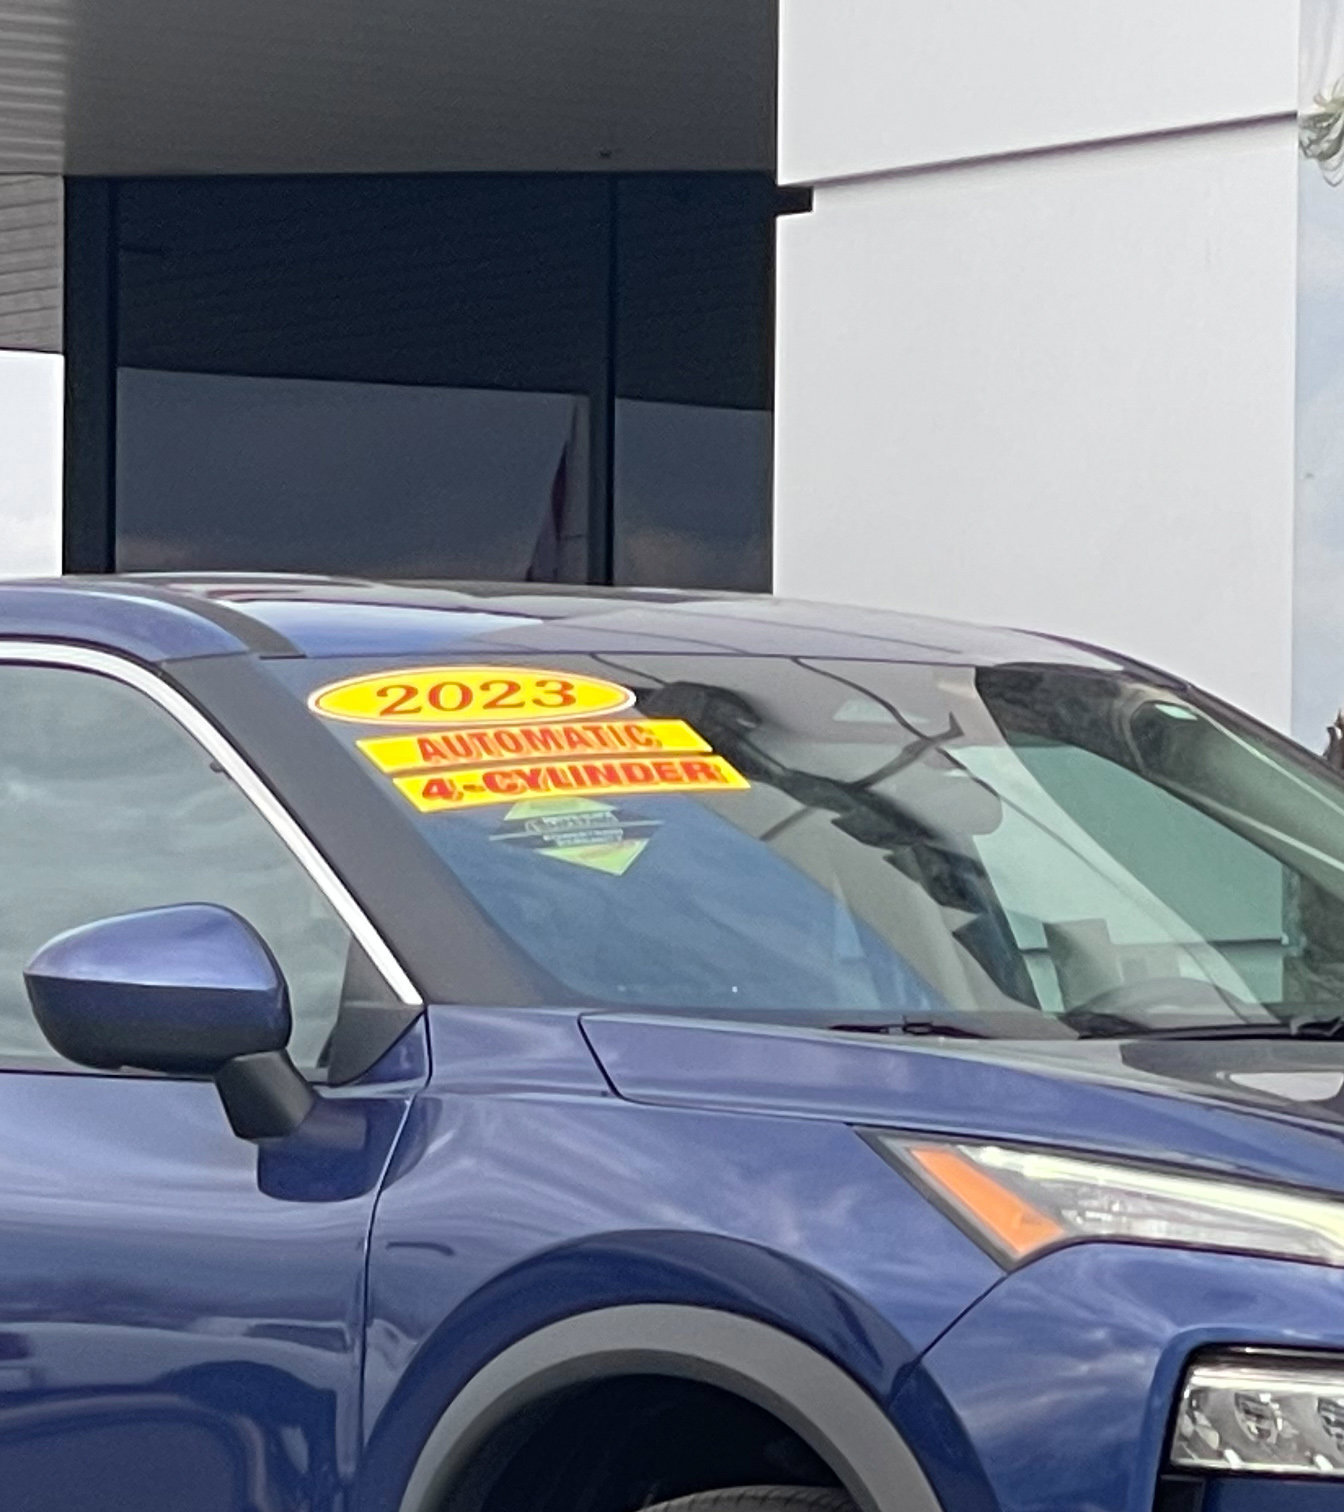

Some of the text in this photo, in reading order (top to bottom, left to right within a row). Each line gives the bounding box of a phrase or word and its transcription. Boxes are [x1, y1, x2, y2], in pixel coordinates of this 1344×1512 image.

[376, 679, 577, 717] 2023
[416, 724, 660, 763] AUTOMATIC
[421, 760, 726, 801] 4-CYLINDER
